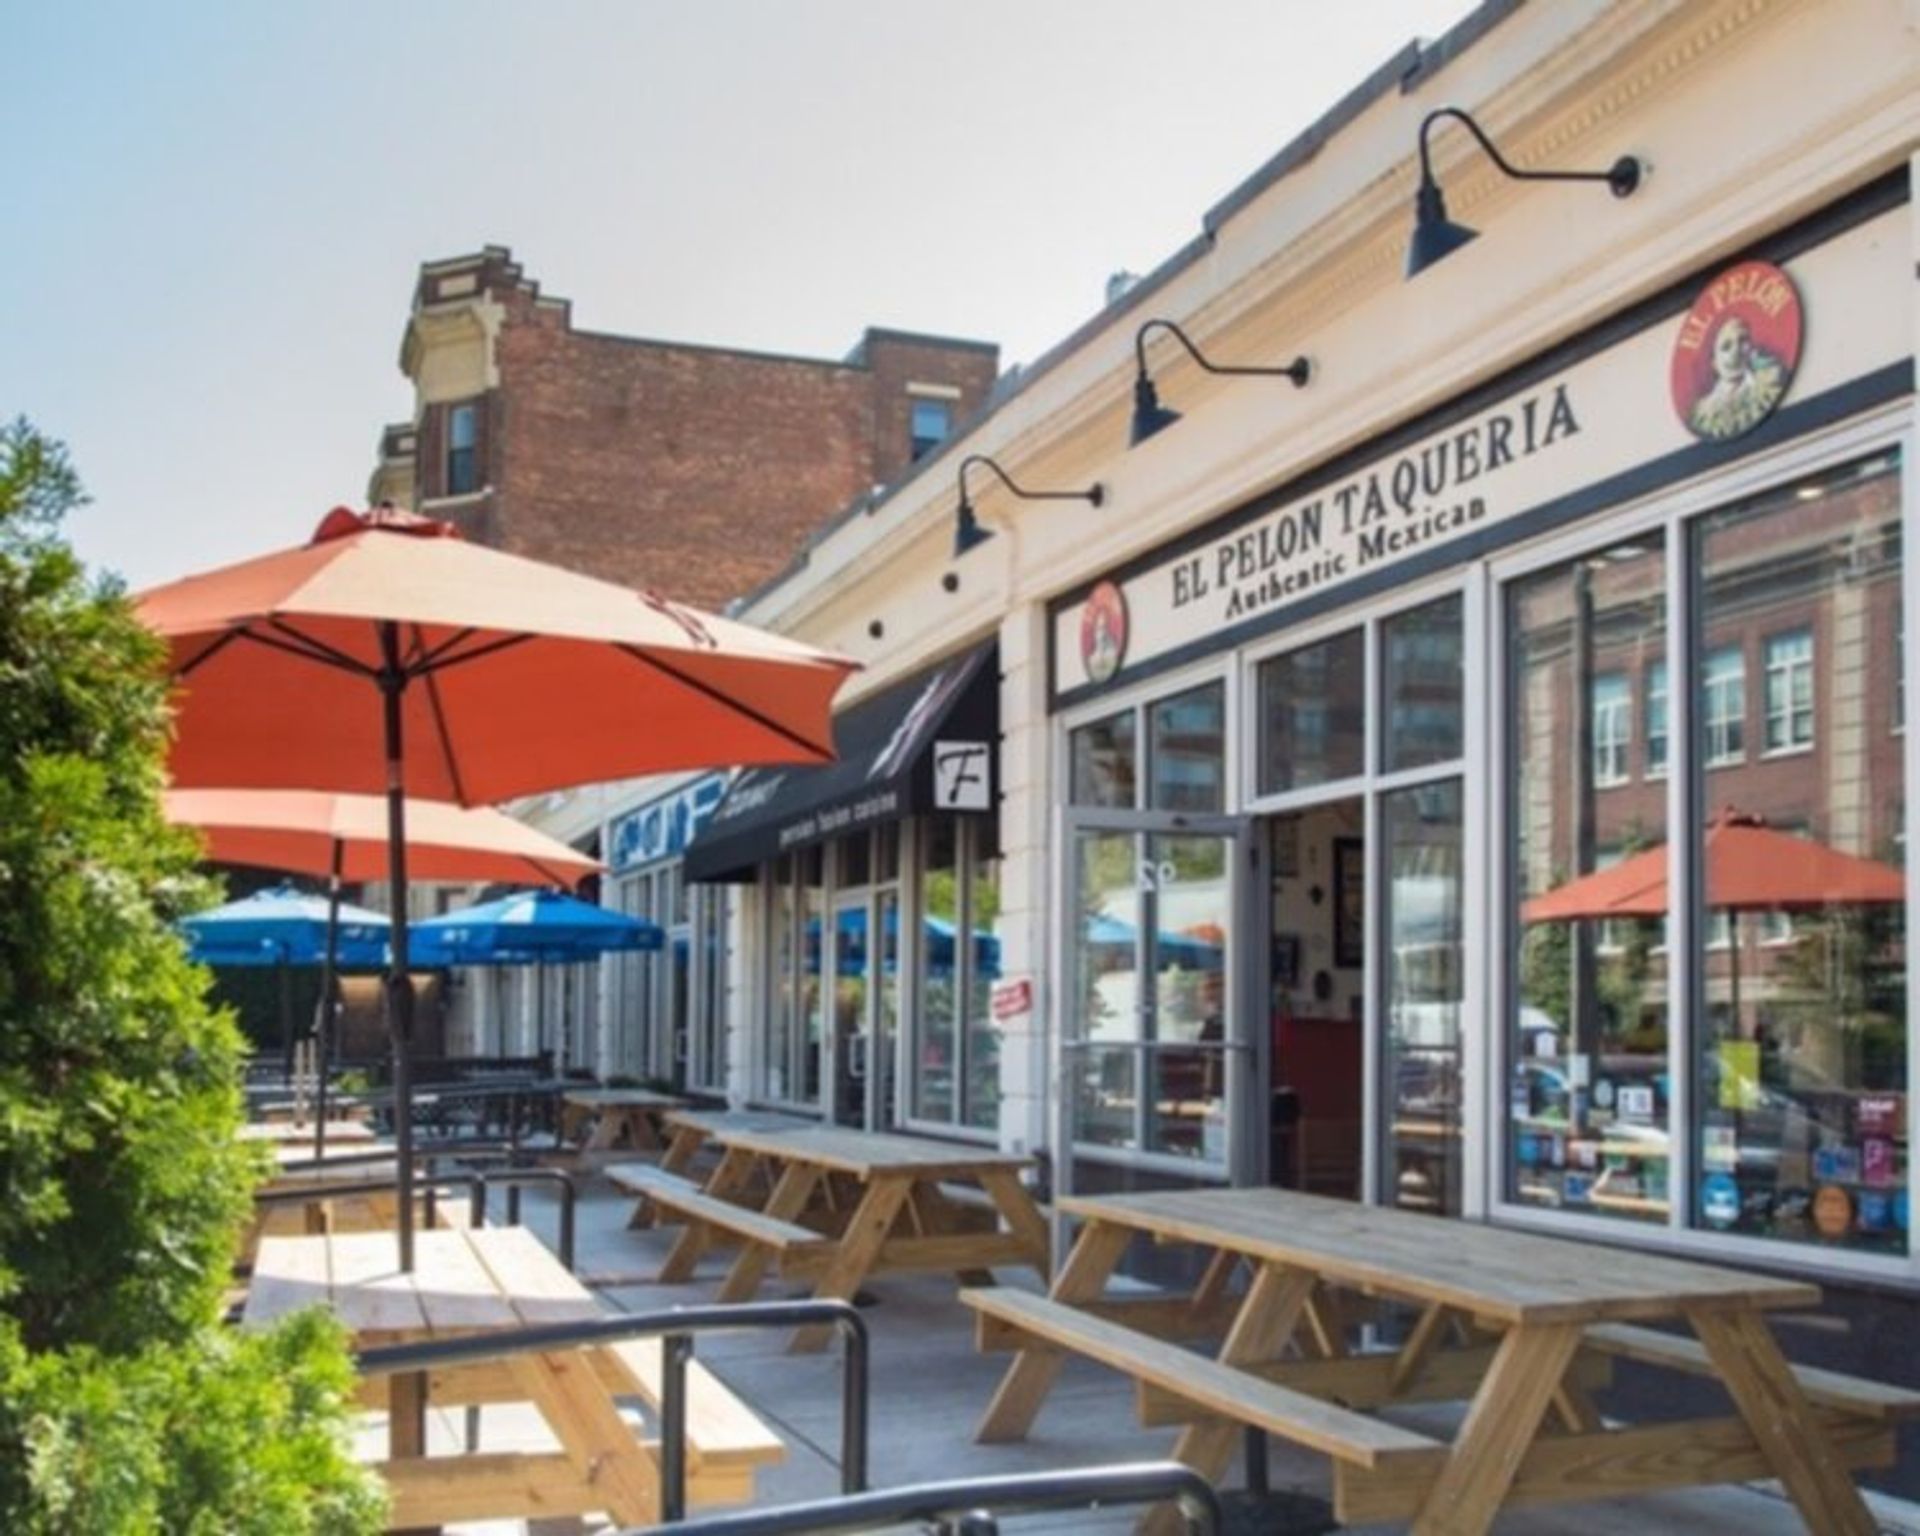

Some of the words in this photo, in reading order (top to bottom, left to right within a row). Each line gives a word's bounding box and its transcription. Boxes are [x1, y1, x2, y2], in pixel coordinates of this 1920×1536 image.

[1681, 315, 1713, 350] EL
[1172, 556, 1209, 609] EL
[1216, 499, 1323, 588] PELON
[1333, 383, 1580, 535] TAQUERIA
[1225, 549, 1346, 620] Authentic
[1357, 496, 1487, 566] Mexican
[938, 747, 985, 804] F
